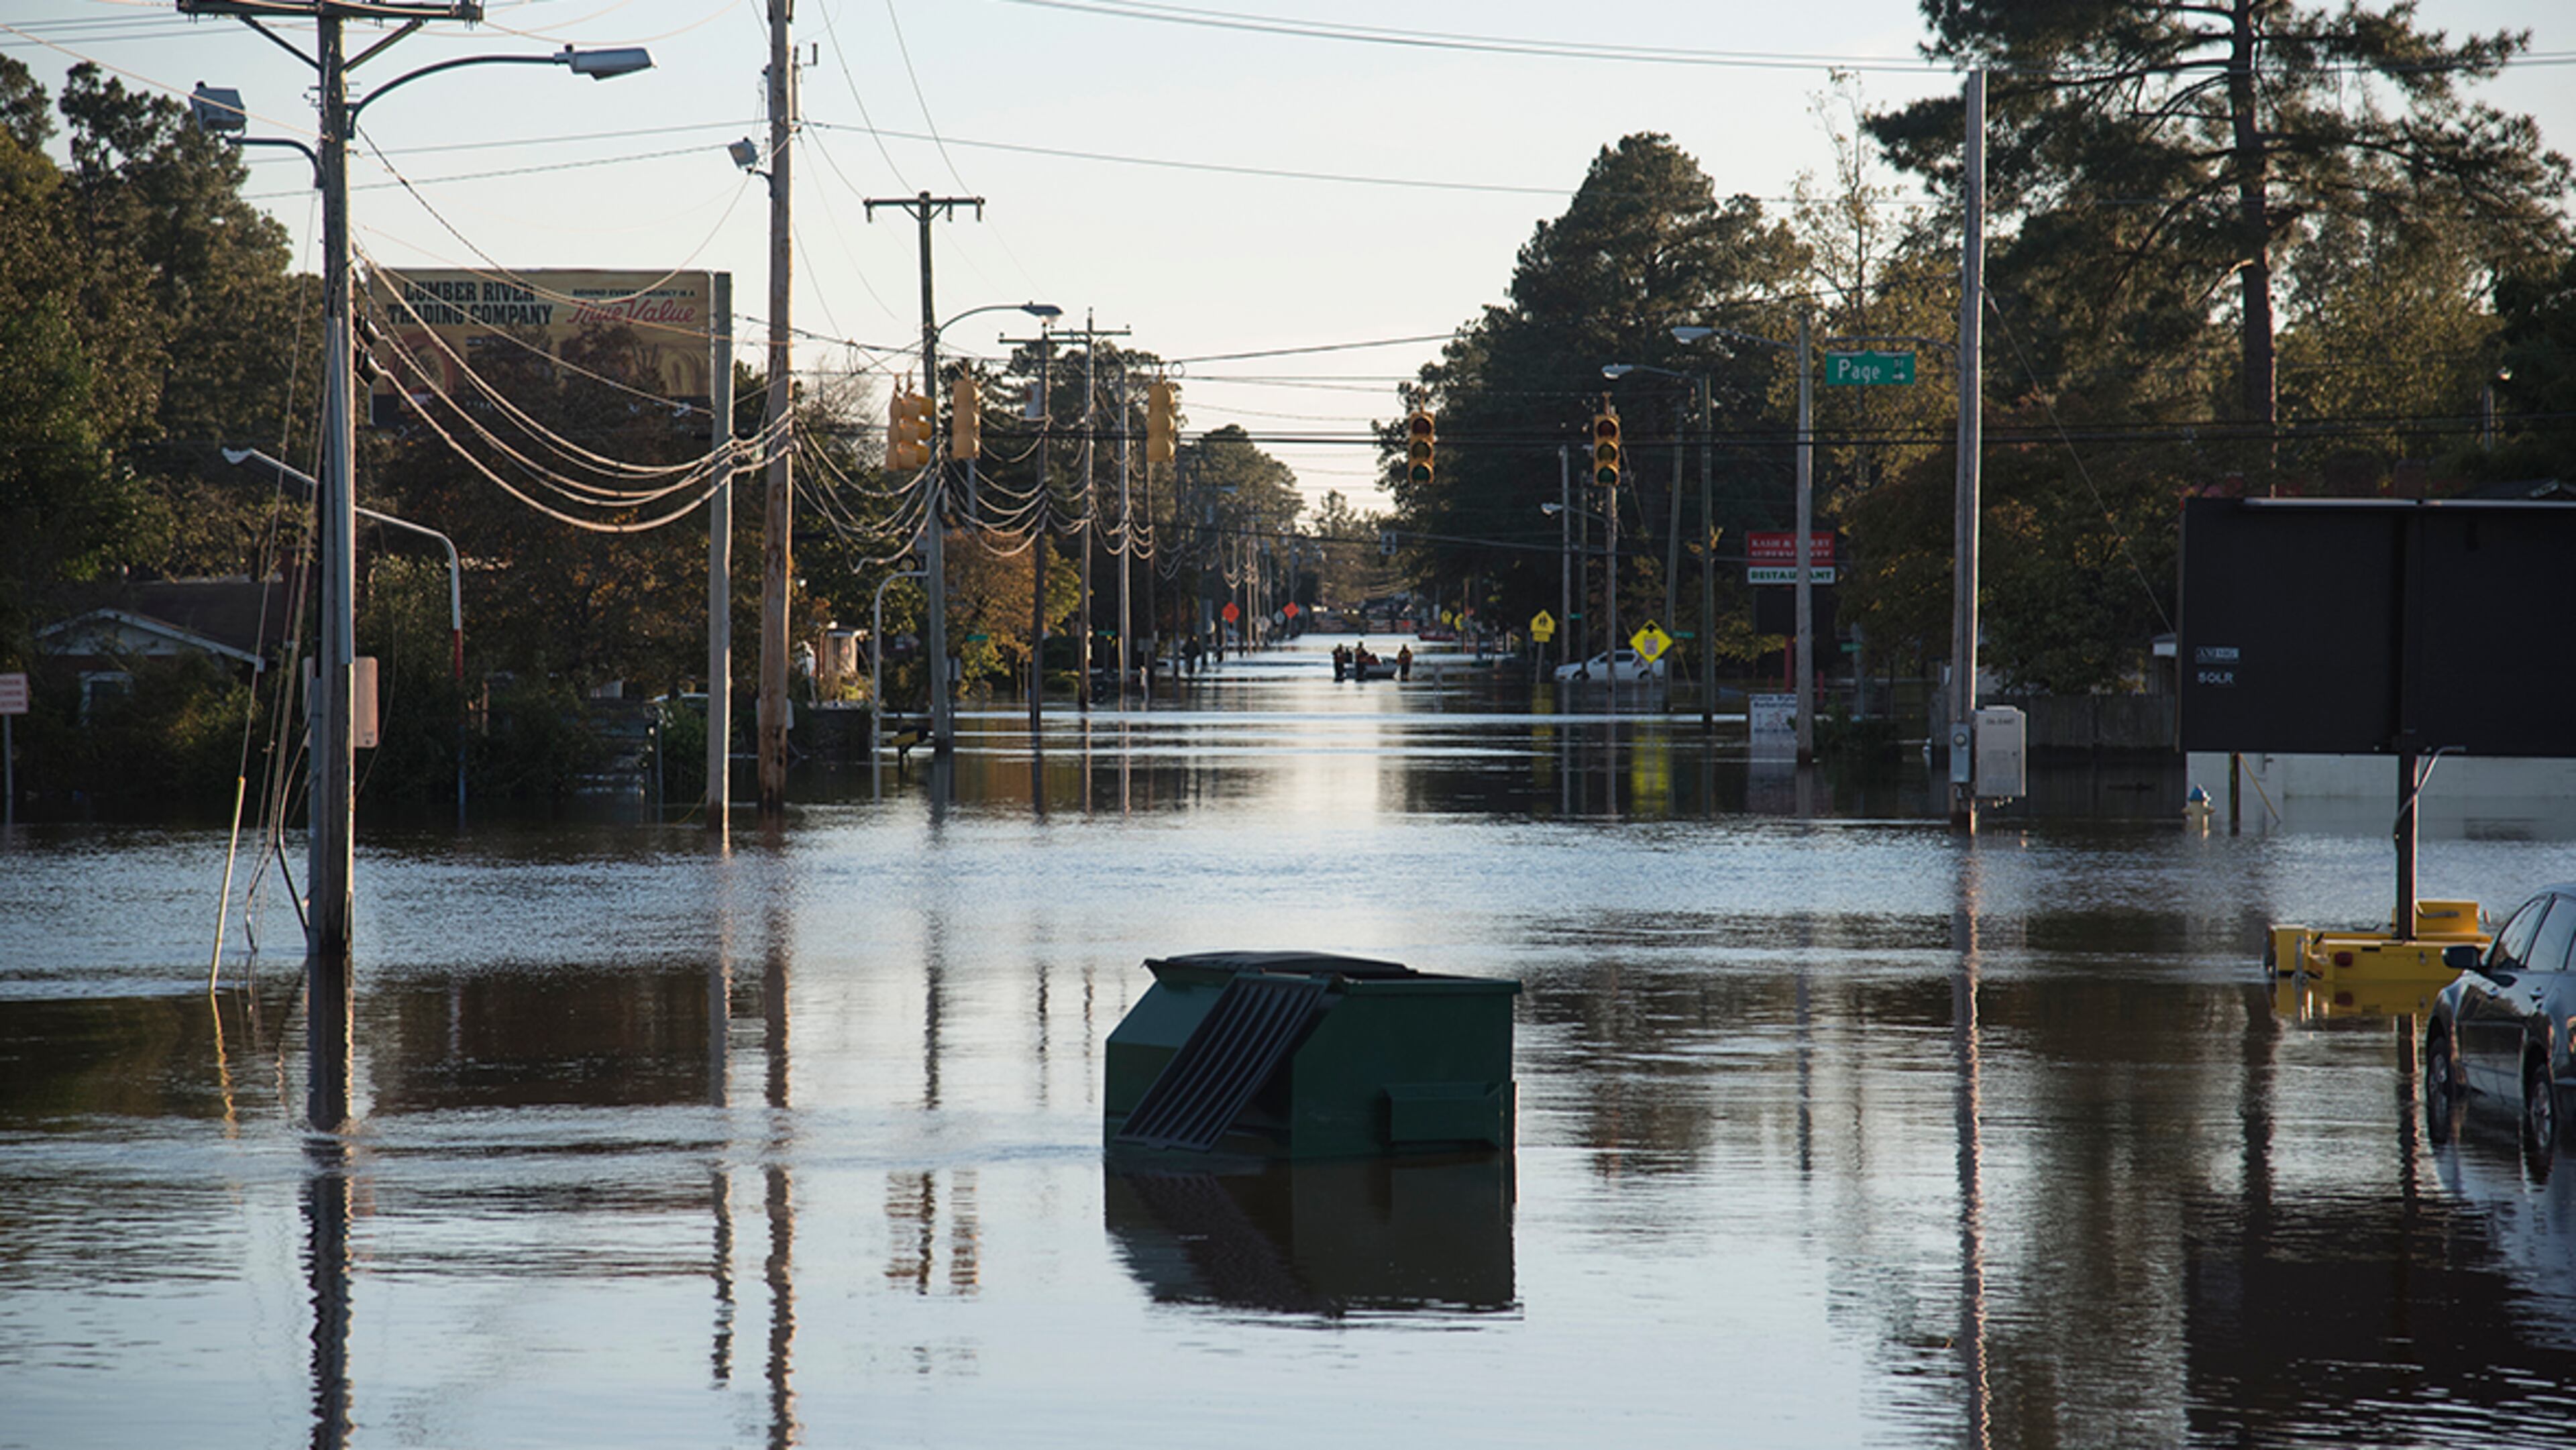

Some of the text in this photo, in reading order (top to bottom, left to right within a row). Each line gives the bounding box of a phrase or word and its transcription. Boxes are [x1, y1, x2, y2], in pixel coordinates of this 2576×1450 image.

[404, 281, 535, 302] LUMBER RIVER
[386, 304, 553, 325] TRADING COMPANY
[567, 298, 696, 324] True Value
[1838, 359, 1881, 384] Page
[1751, 571, 1831, 579] RESTAUANT
